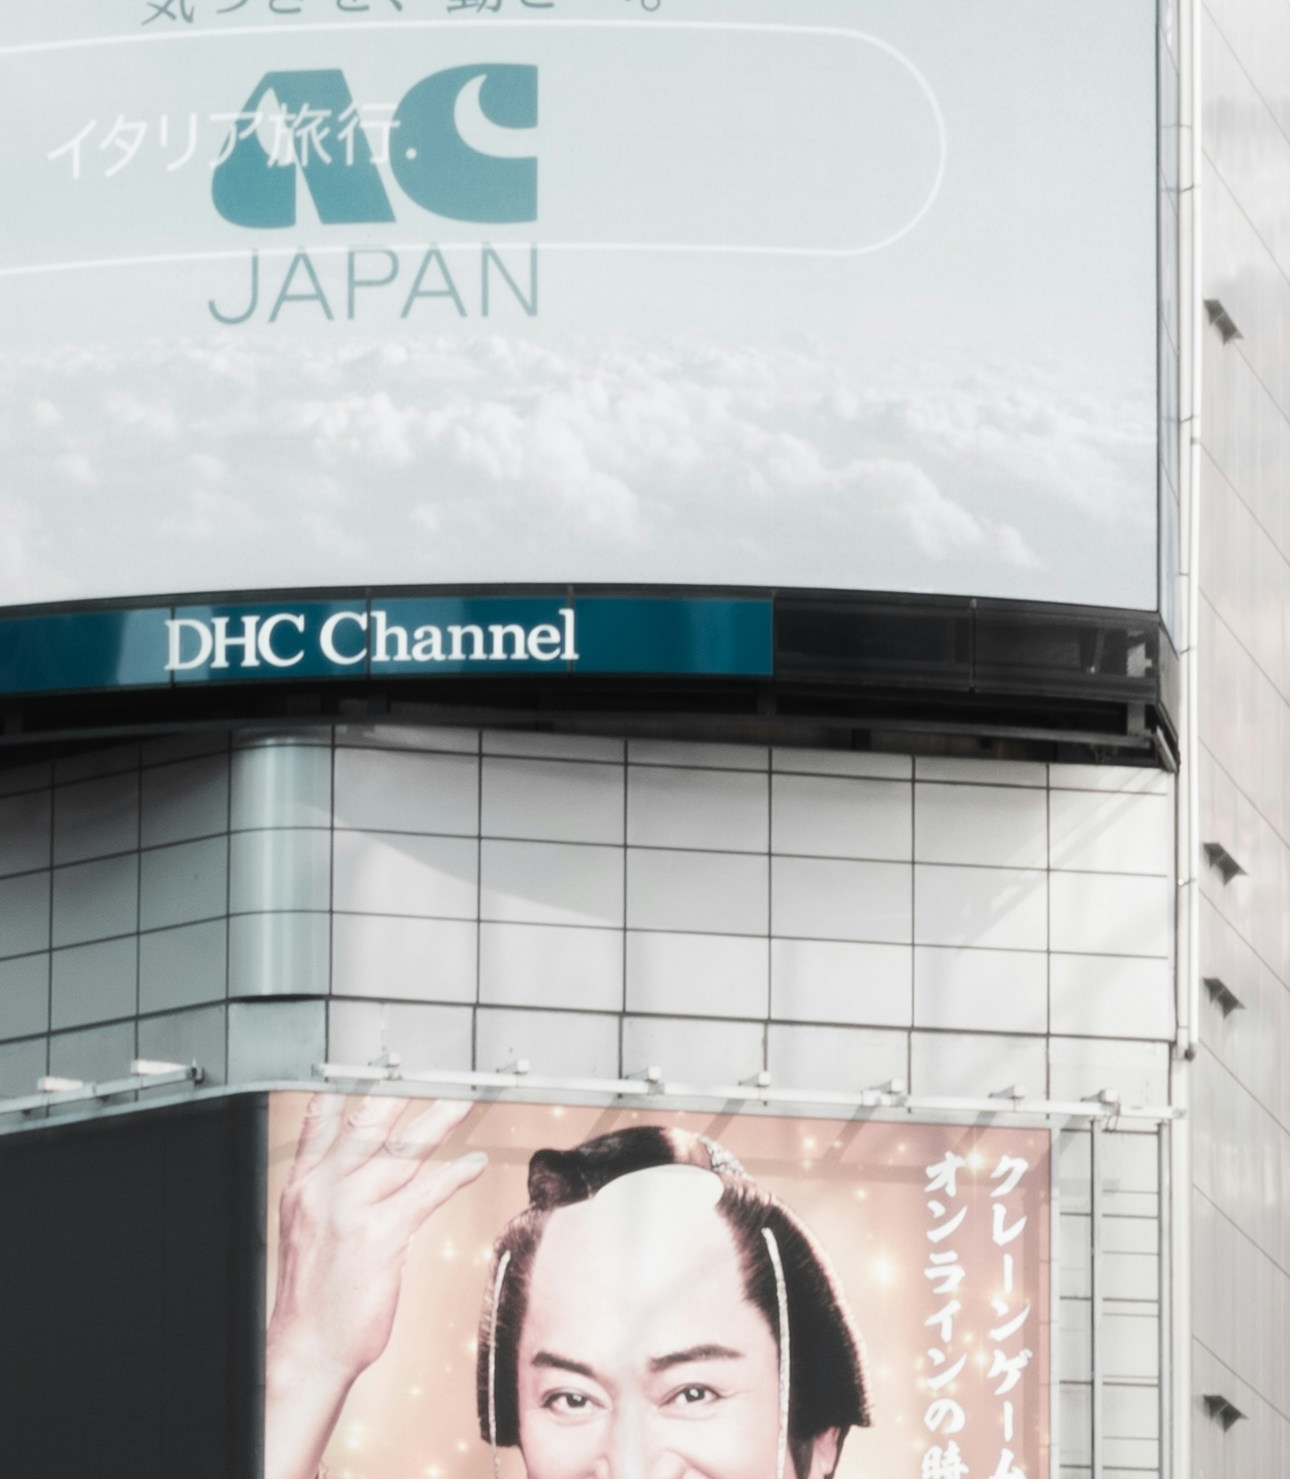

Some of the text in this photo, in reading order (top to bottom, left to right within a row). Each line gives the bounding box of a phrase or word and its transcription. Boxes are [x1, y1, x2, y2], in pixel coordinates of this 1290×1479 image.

[210, 62, 538, 230] AC
[208, 240, 540, 327] JAPAN
[164, 609, 579, 671] DHC Channel
